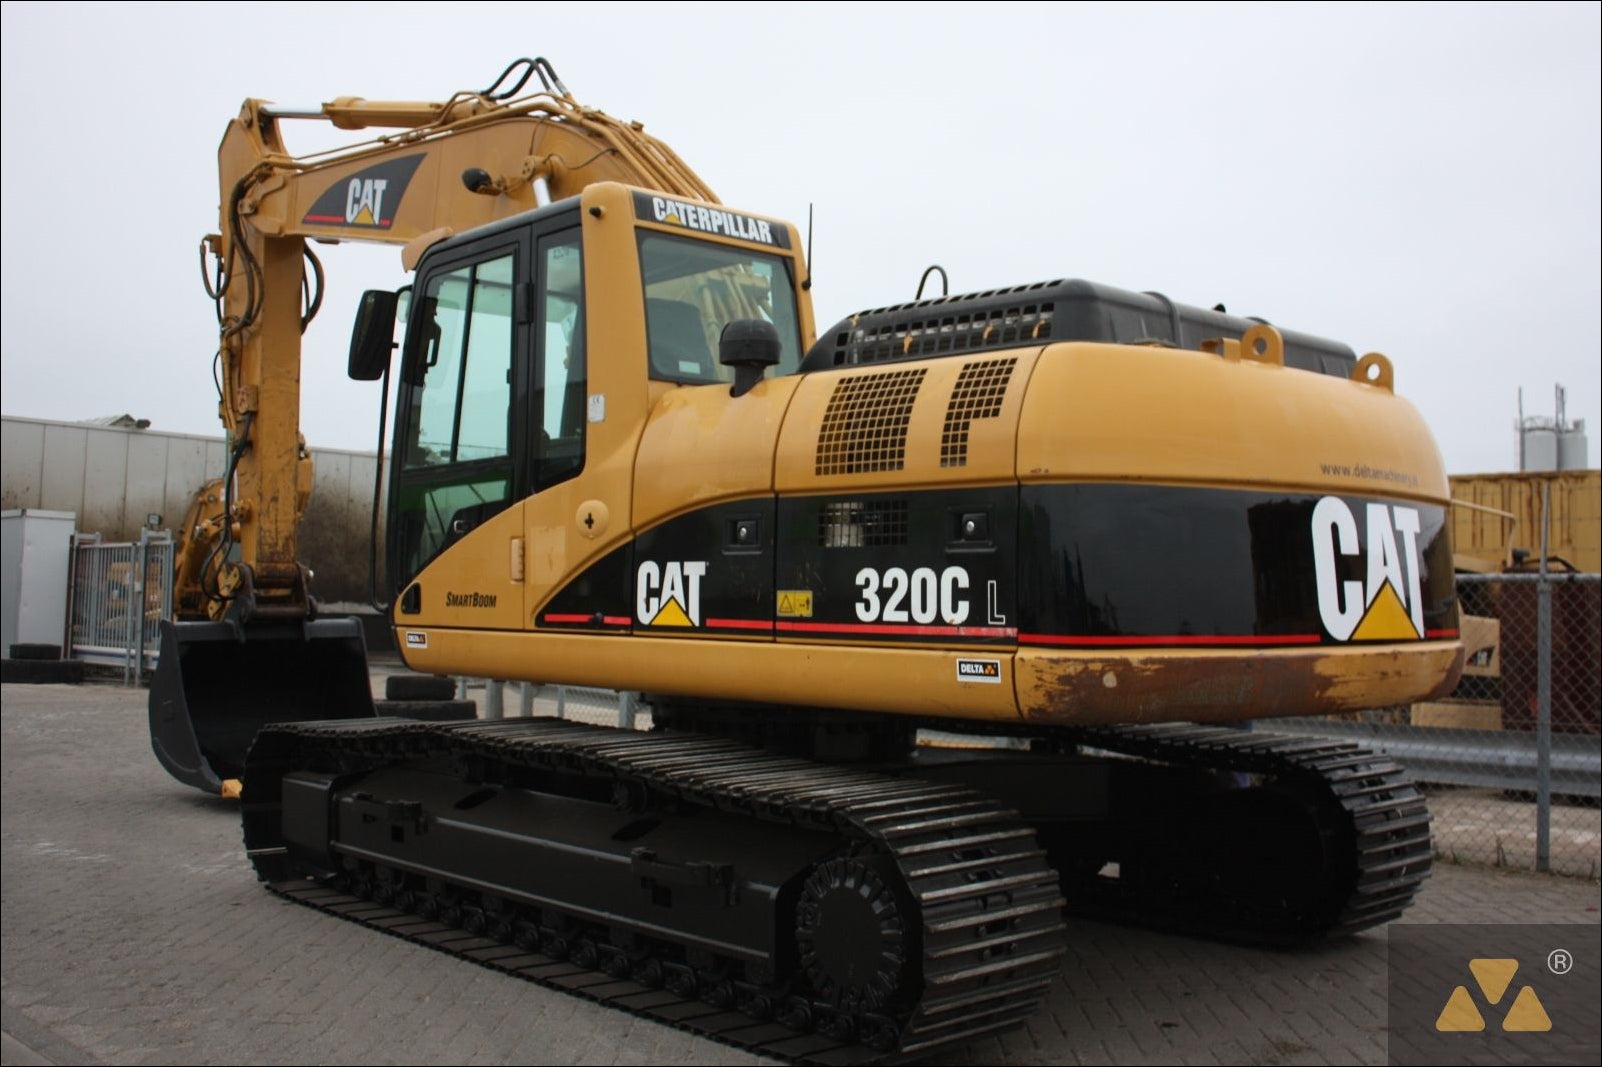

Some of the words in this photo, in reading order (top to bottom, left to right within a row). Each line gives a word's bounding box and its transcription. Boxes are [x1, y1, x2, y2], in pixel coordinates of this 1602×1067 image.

[346, 178, 387, 225] CAT
[652, 197, 773, 244] CATERPILLAR
[637, 560, 706, 627] CAT
[1311, 496, 1425, 641] CAT
[855, 566, 970, 625] 320C
[987, 580, 1006, 625] L
[960, 663, 984, 674] DELTA
